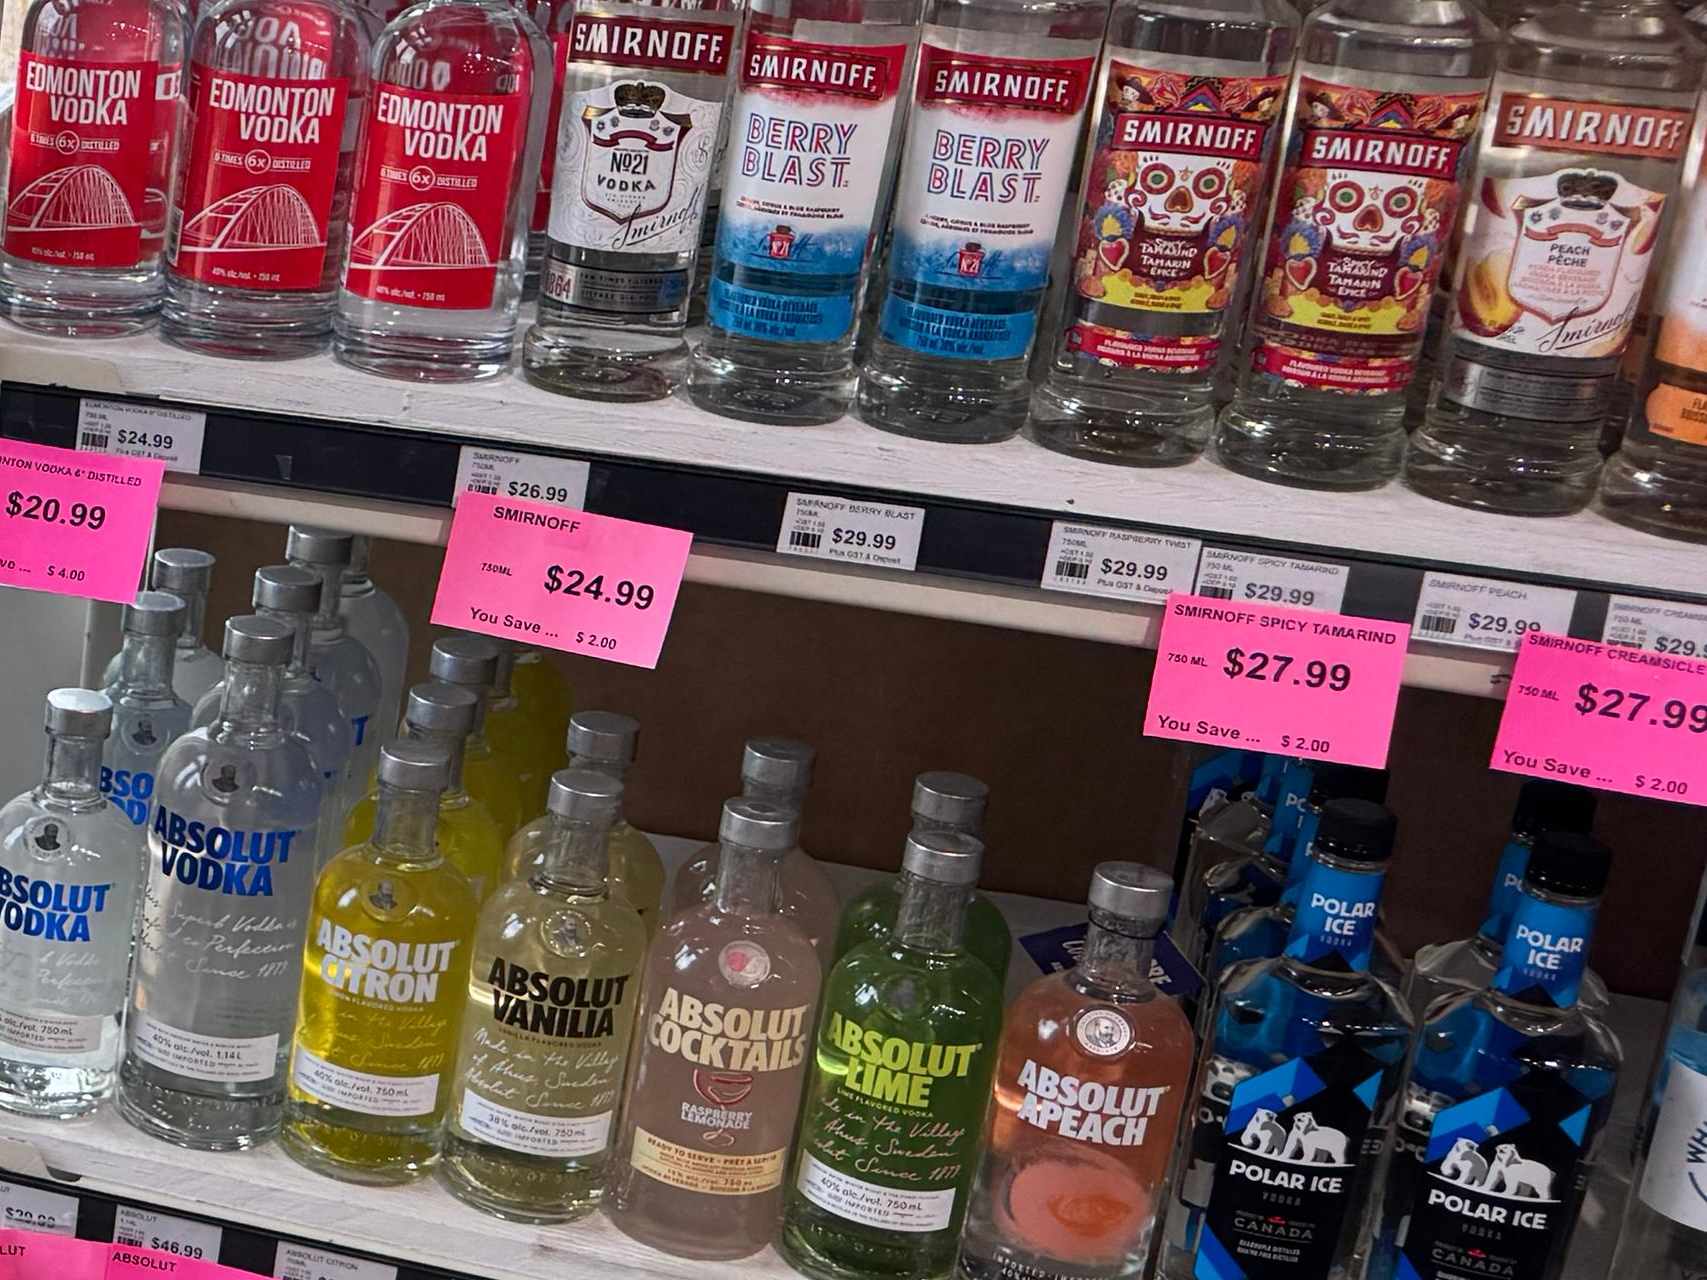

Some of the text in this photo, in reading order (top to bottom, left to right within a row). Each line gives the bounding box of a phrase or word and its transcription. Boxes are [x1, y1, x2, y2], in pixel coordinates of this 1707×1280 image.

[574, 20, 723, 64] SMIRNOFF
[26, 59, 141, 100] EDMONTON
[750, 52, 876, 92] SMIRNOFF
[934, 69, 1068, 104] SMIRNOFF
[50, 89, 128, 126] VODKA
[377, 90, 504, 134] EDMONTON
[403, 124, 487, 162] VODKA
[747, 112, 858, 154] BERRY
[1123, 116, 1257, 154] SMIRNOFF
[1506, 103, 1685, 152] SMIRNOFF
[742, 149, 850, 190] BLAST
[1550, 241, 1591, 256] PEACH
[116, 428, 174, 450] $24.99
[35, 463, 71, 476] VODKA
[87, 472, 141, 487] DISTILLED
[507, 480, 568, 504] $26.99
[5, 491, 106, 530] $20.99
[492, 504, 581, 536] SMIRNOFF
[832, 528, 896, 550] $29.99
[58, 569, 85, 581] 4.00
[543, 562, 656, 611] $24.99
[1101, 558, 1169, 581] $29.99
[469, 606, 540, 633] You Save
[1174, 604, 1396, 645] SMIRNOFF SPICY TAMARIND
[588, 632, 617, 650] 2.00
[1529, 634, 1705, 675] SMIRNOFF CREAMSICLE
[1223, 647, 1351, 692] $27.99
[1158, 715, 1240, 739] You Save
[1575, 683, 1707, 734] $27.99
[1296, 738, 1329, 753] 2.00
[1504, 750, 1591, 778] You Save
[1651, 777, 1687, 794] 2.00
[154, 804, 296, 865] ABSOLUT
[161, 845, 274, 898] VODKA
[1311, 892, 1375, 919] POLAR
[1324, 914, 1355, 936] ICE
[315, 918, 457, 975] ABSOLUT
[321, 952, 438, 1004] CITRON
[488, 956, 628, 1009] ABSOLUT
[491, 989, 615, 1040] VANILIA
[658, 986, 807, 1041] ABSOLUT
[647, 1024, 807, 1073] COCKTAILS
[826, 1013, 982, 1078] ABSOLUT
[845, 1058, 933, 1109] LIME
[1017, 1059, 1170, 1118] ABSOLUT
[681, 1113, 750, 1130] LEMONADE
[1016, 1102, 1147, 1147] APEACH
[1229, 1159, 1343, 1195] POLAR ICE
[1234, 1215, 1314, 1240] CANADA
[1428, 1189, 1546, 1230] POLAR ICE
[112, 1251, 177, 1273] ABSOLUT
[150, 1236, 203, 1260] $46.99
